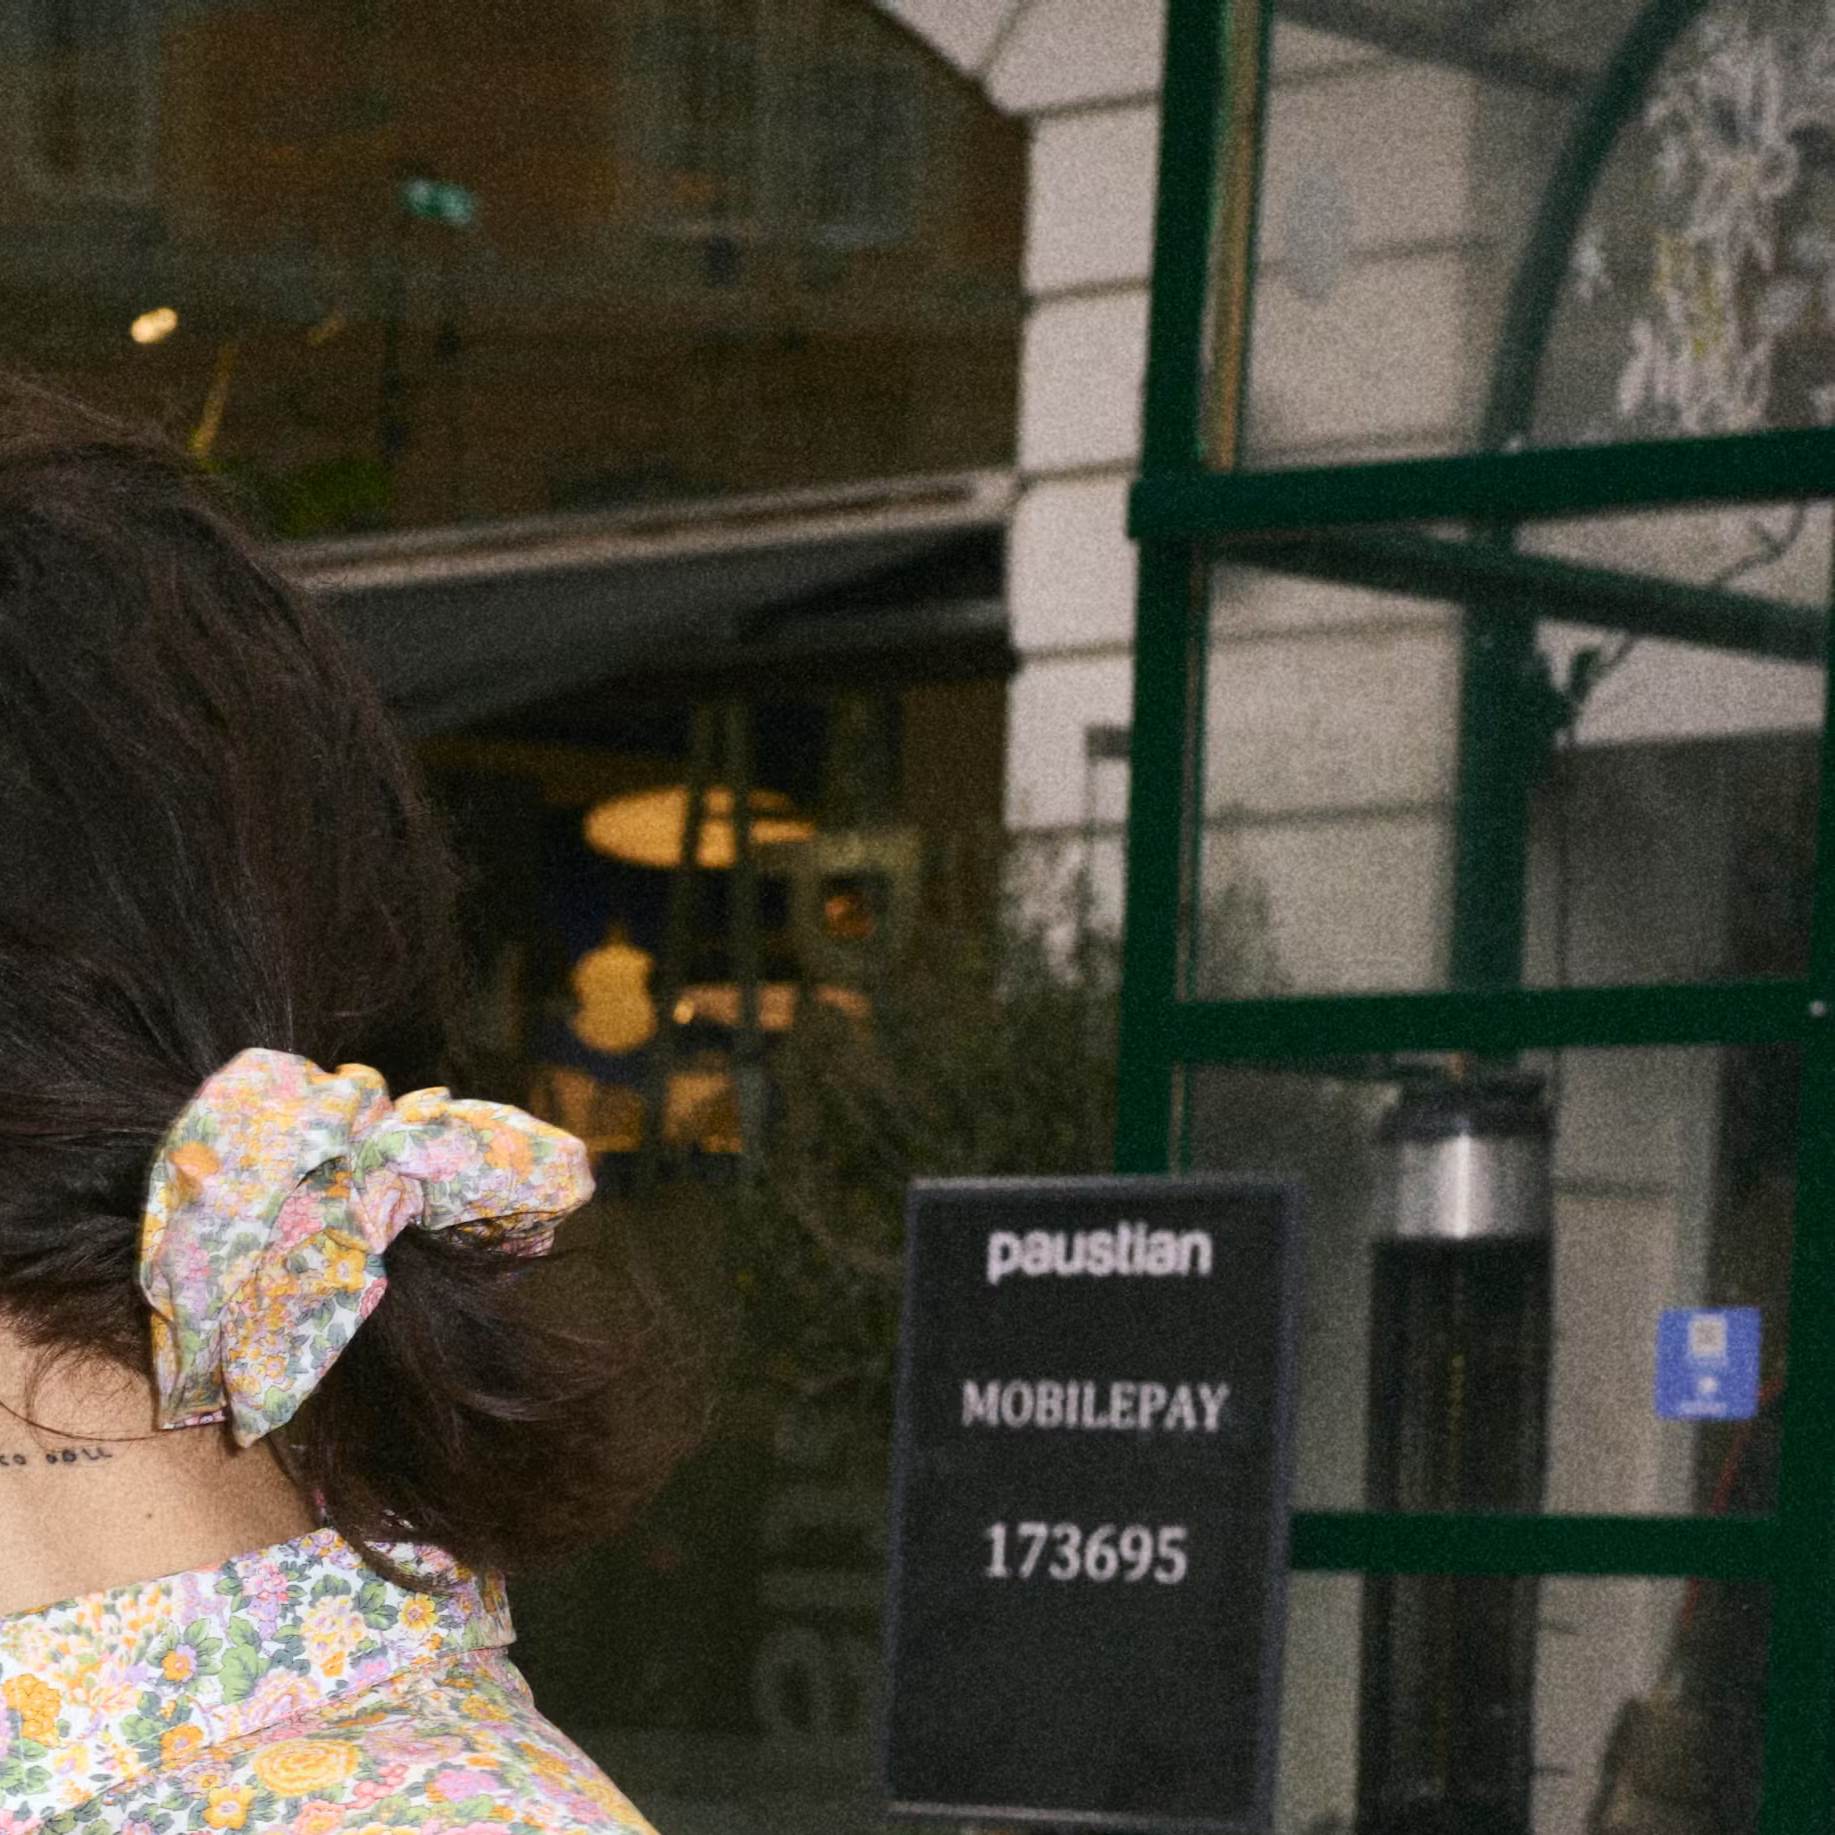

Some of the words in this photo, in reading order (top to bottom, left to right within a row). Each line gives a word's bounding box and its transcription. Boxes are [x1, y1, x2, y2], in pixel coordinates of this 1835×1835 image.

[987, 1221, 1213, 1285] paustian
[963, 1379, 1230, 1432] MOBILEPAY
[985, 1521, 1189, 1584] 173695
